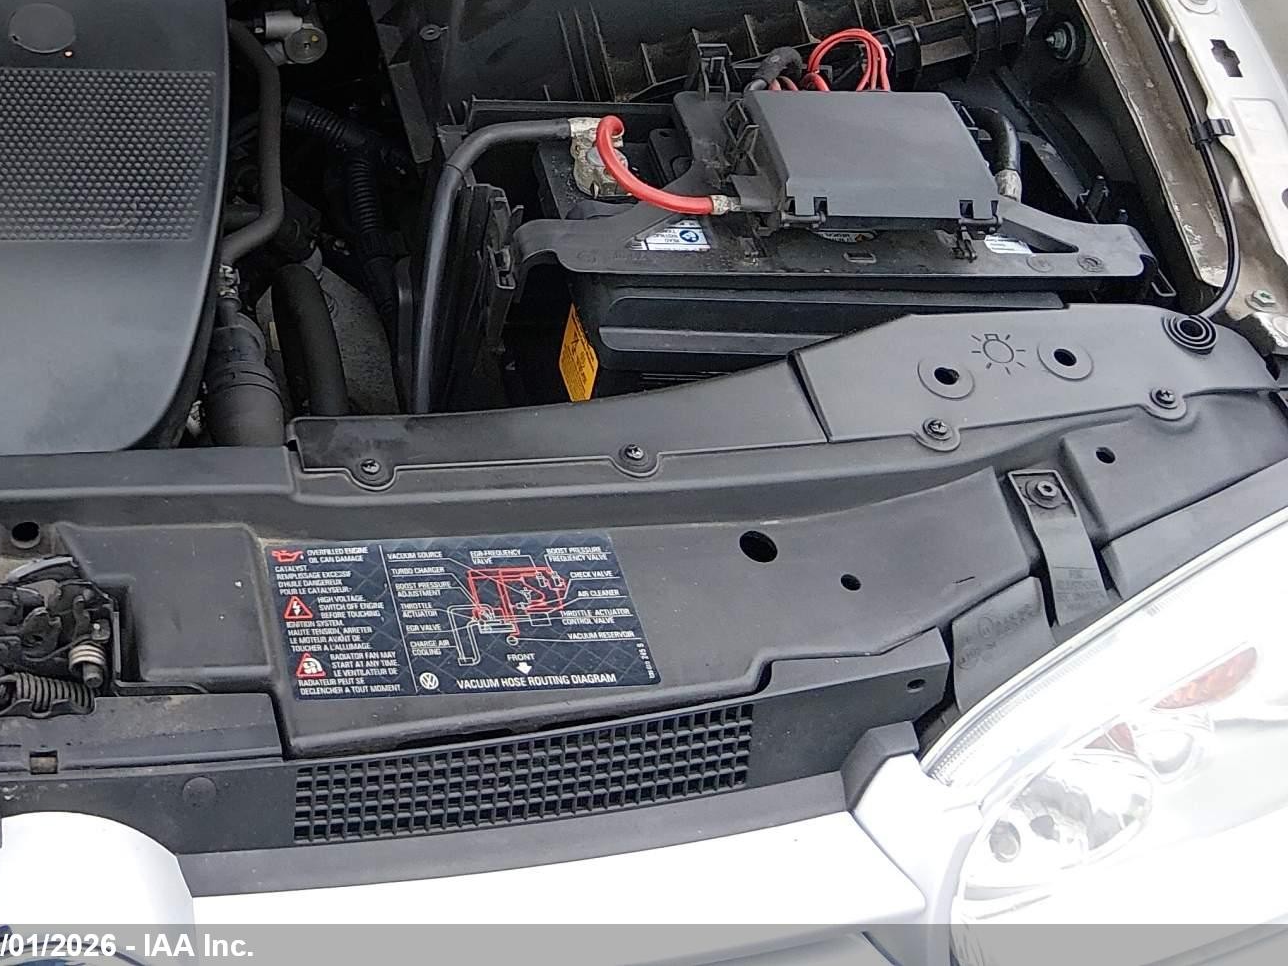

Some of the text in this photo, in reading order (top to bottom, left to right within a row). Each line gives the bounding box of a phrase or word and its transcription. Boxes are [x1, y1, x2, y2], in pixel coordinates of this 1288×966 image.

[548, 554, 586, 562] FREQUENCY
[402, 610, 437, 618] ACTUATOR
[593, 616, 615, 624] VALVE
[567, 632, 598, 640] VACUUM
[507, 653, 535, 661] FRONT
[456, 673, 617, 689] VACUUM HOSE ROUTING DIAGRAM
